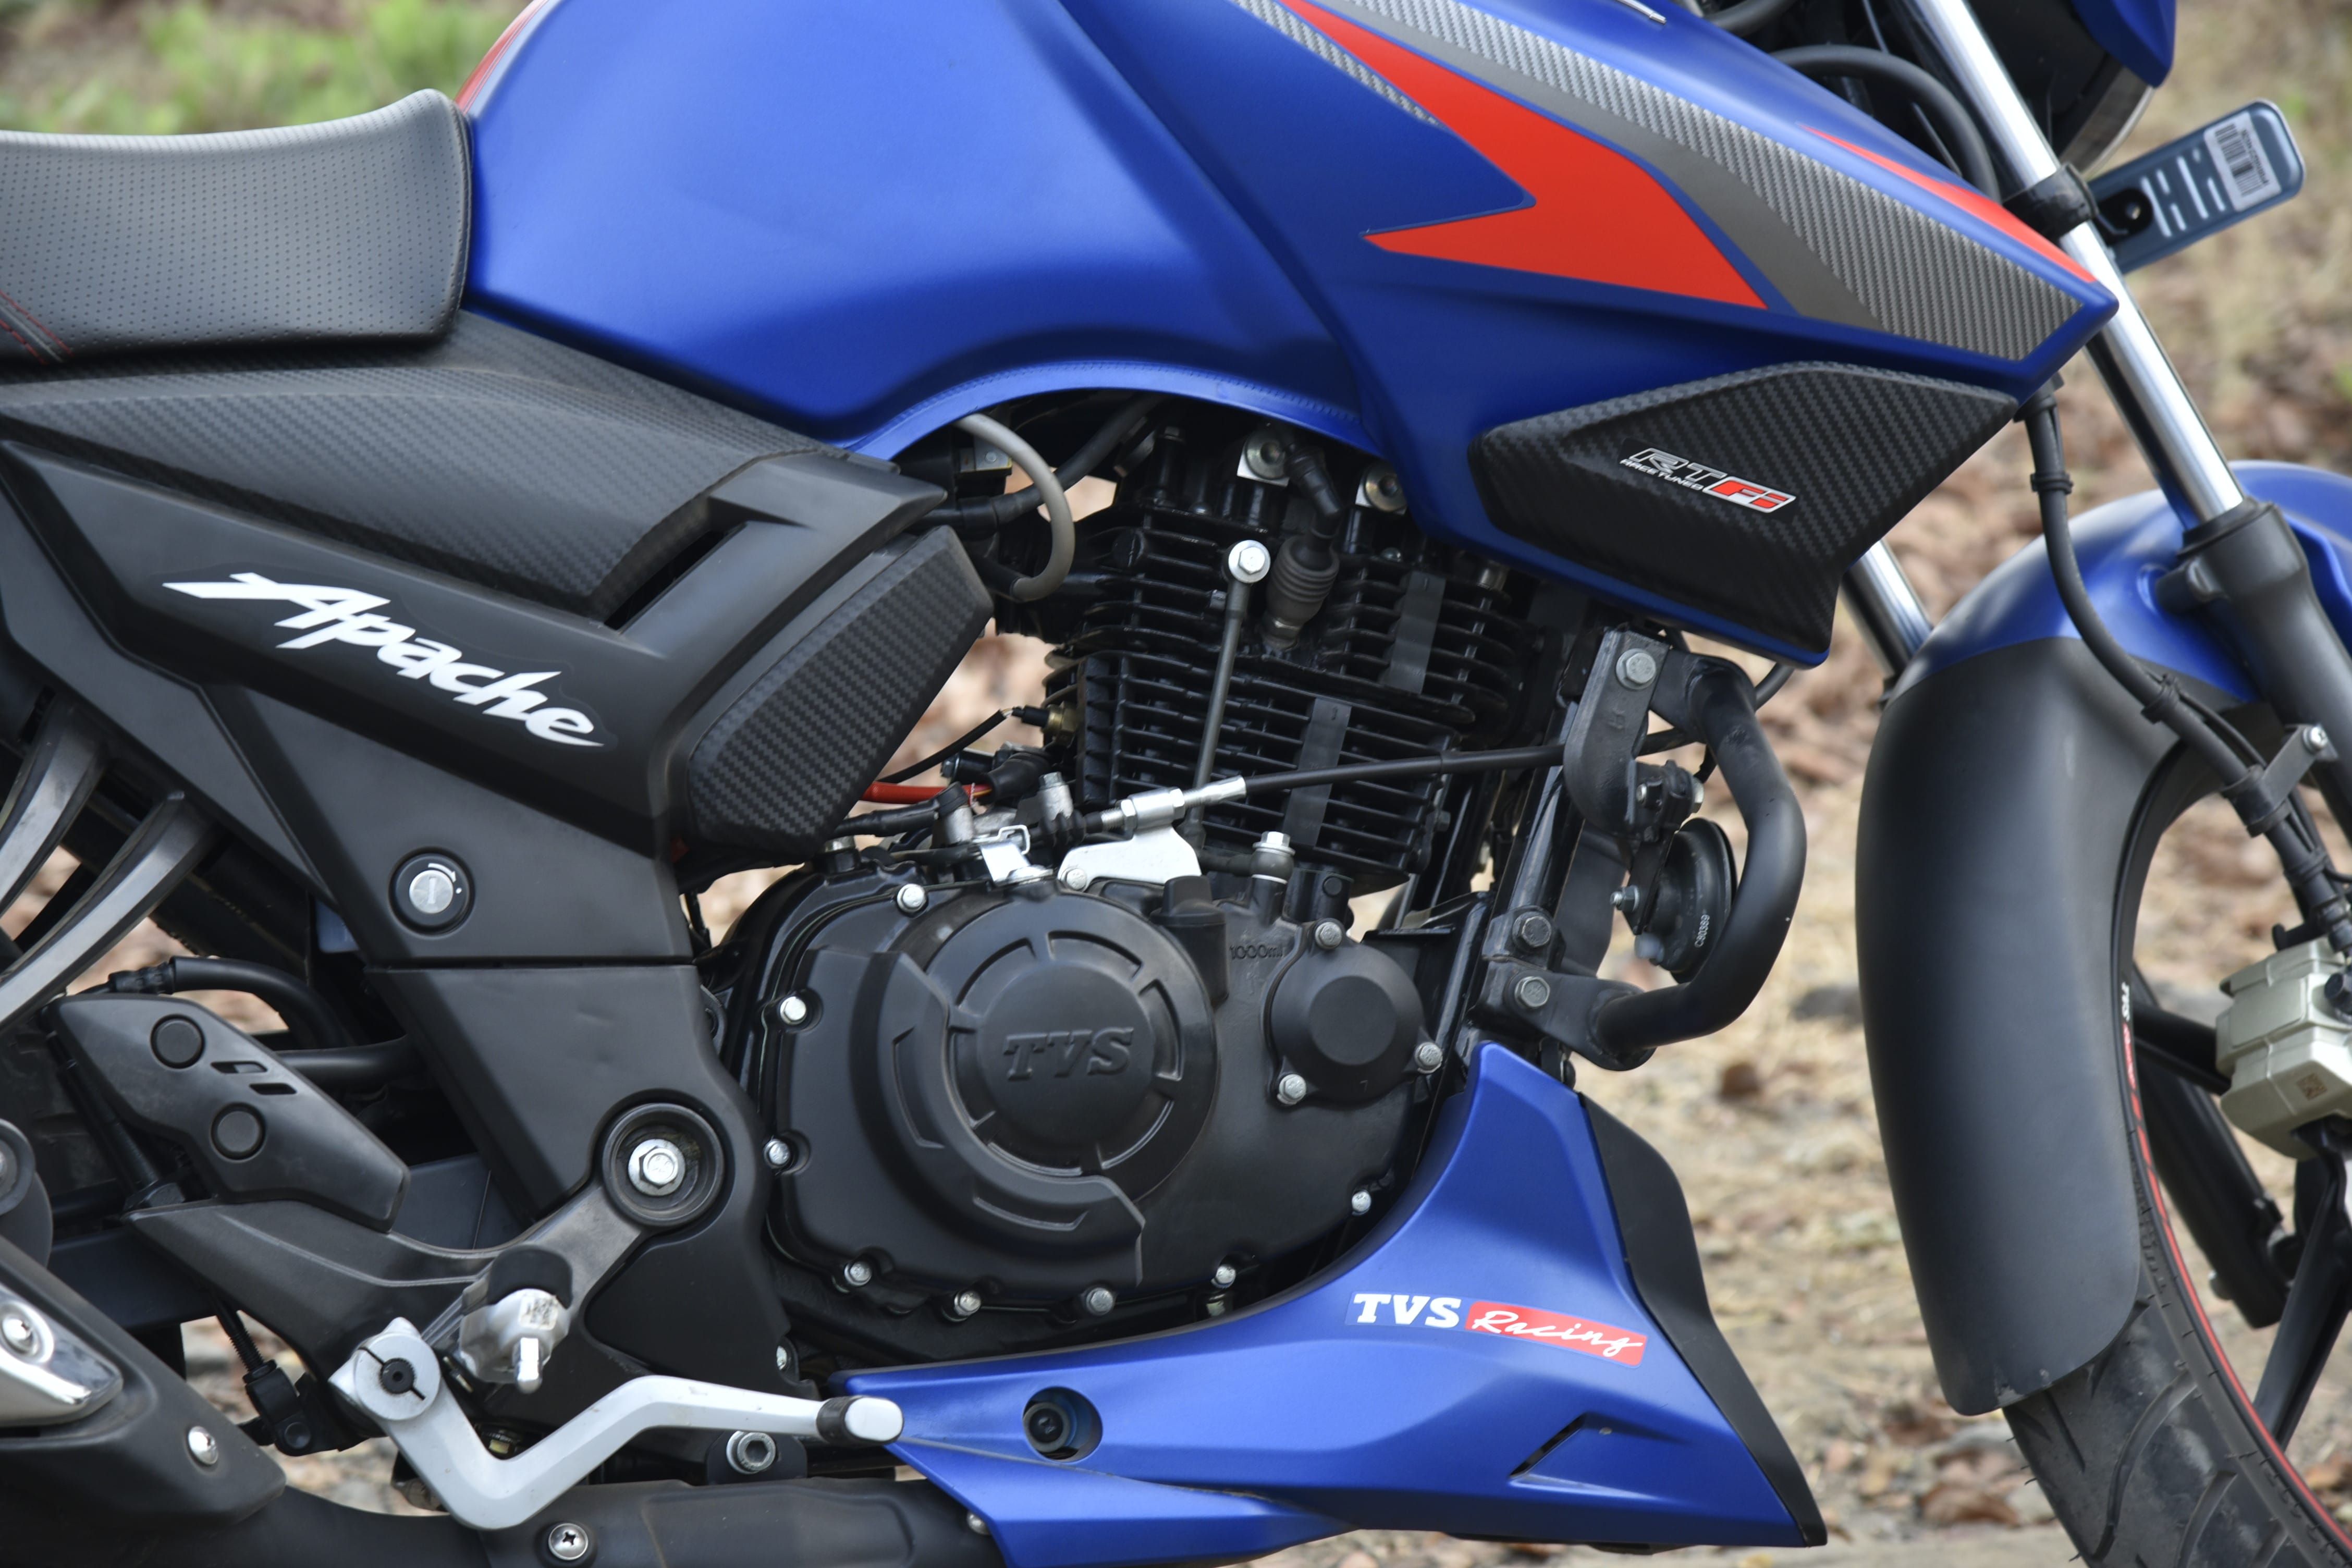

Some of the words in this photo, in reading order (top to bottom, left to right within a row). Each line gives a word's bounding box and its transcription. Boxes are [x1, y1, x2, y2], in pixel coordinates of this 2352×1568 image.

[1619, 459, 1656, 475] RACE
[1658, 472, 1704, 491] TUNED
[163, 572, 604, 746] Apache
[1229, 944, 1282, 960] 1000ml
[1004, 1027, 1134, 1081] TVS
[1354, 1293, 1462, 1328] TVS
[1472, 1310, 1644, 1357] Racing
